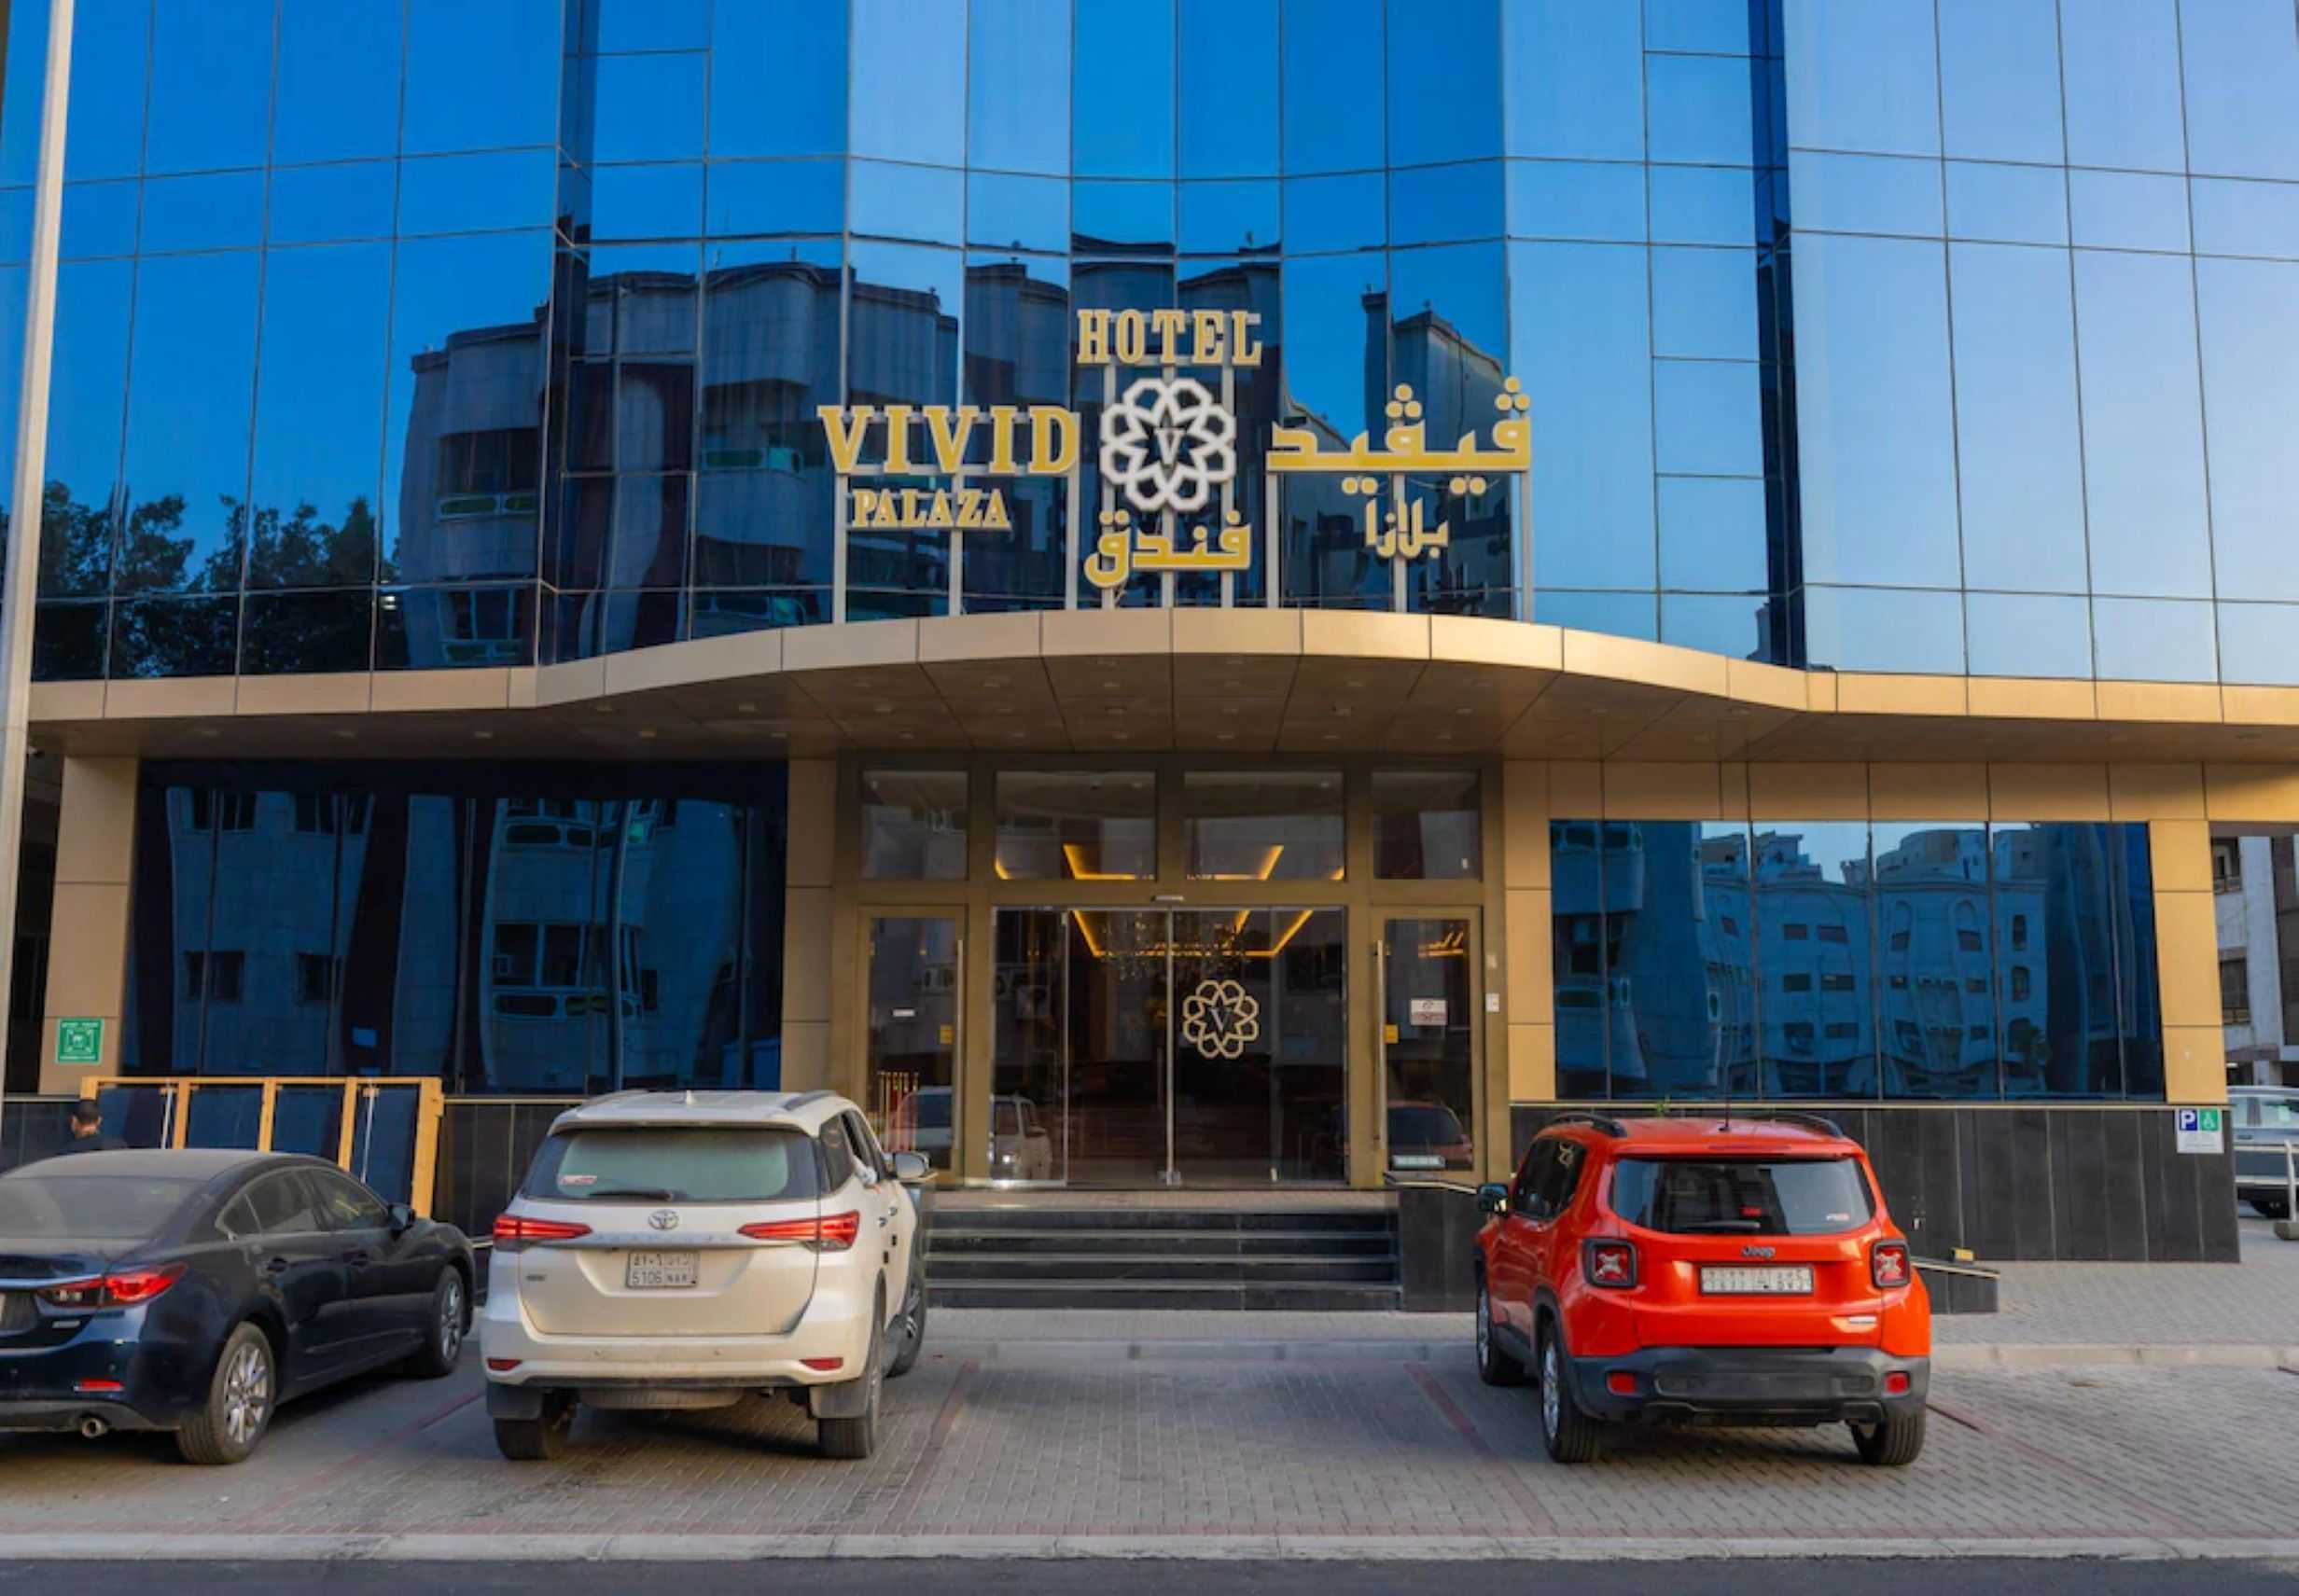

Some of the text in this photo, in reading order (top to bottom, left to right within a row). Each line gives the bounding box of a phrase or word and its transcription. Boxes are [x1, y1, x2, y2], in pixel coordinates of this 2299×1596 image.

[1077, 309, 1262, 366] HOTEL
[816, 405, 1080, 474] VIVID
[851, 488, 1011, 529] PALAZA
[1365, 497, 1448, 559] بلازا
[1084, 509, 1251, 588] فندق
[2181, 1110, 2195, 1130] P
